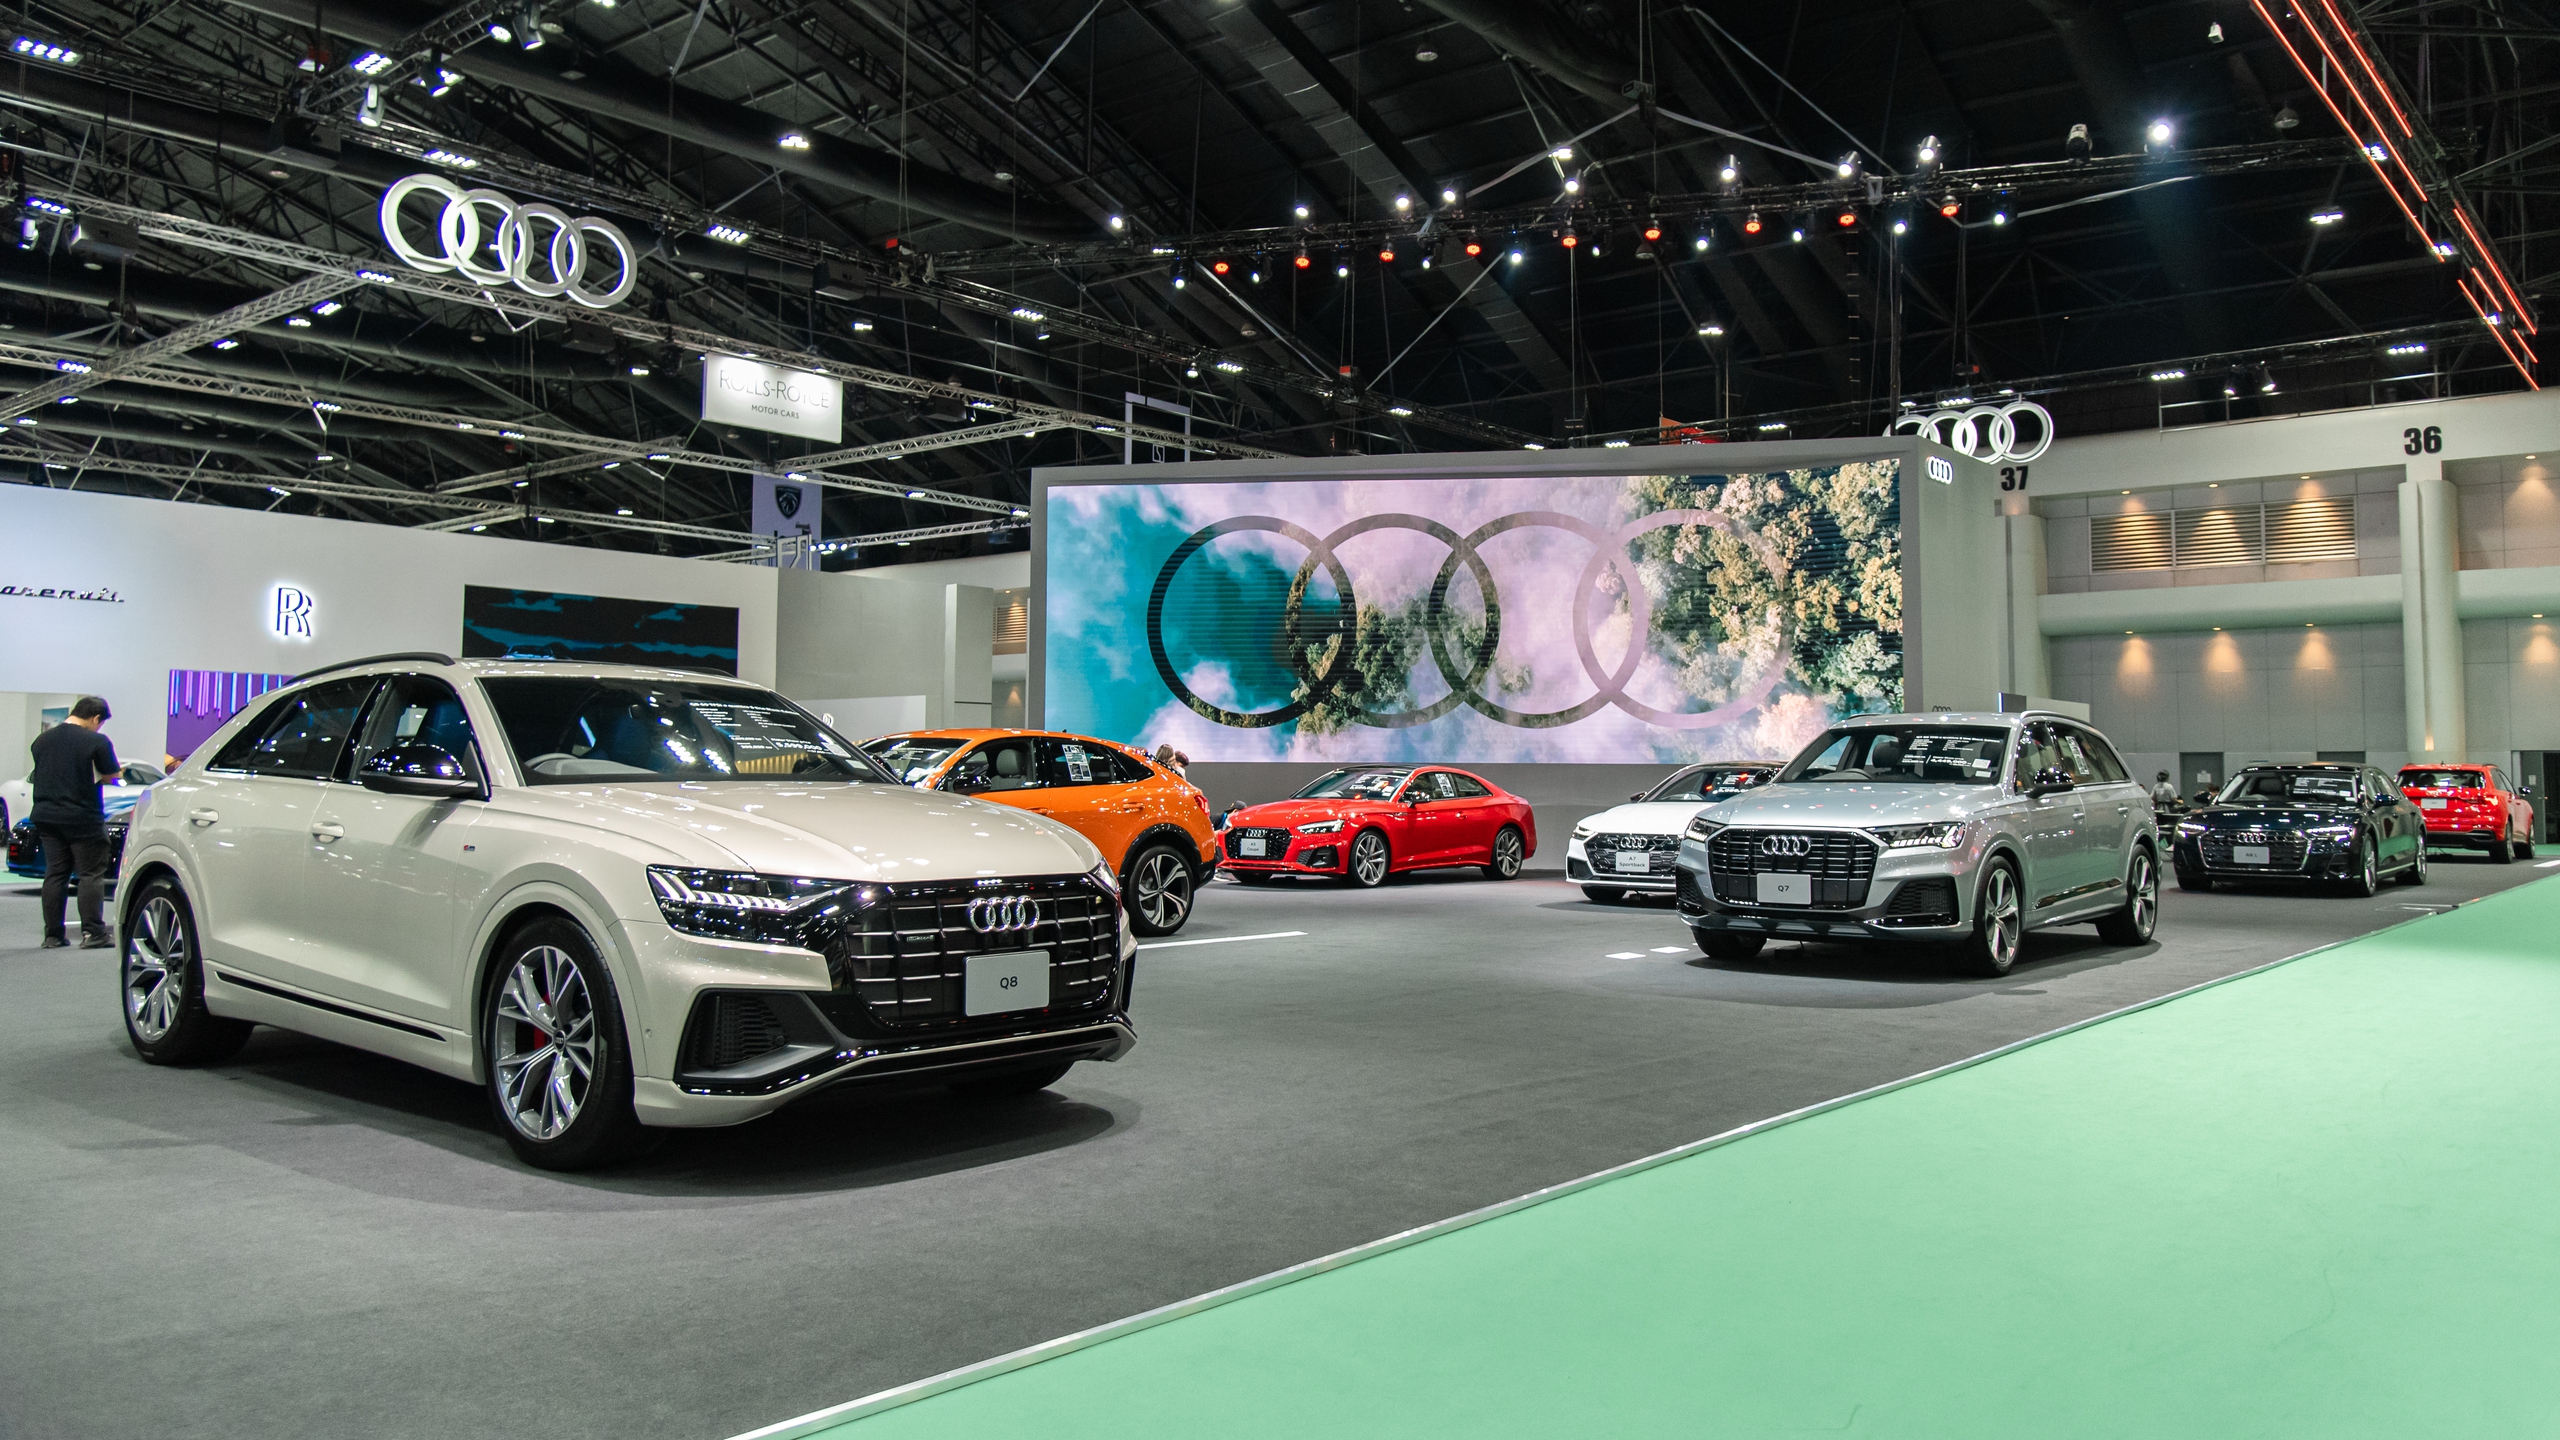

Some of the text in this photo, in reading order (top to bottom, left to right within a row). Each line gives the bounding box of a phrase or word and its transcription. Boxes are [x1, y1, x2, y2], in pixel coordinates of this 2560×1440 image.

[751, 404, 800, 419] MOTOR CARS
[2403, 425, 2442, 456] 36
[2000, 465, 2029, 491] 37
[0, 586, 125, 602] aserati
[1000, 976, 1018, 990] Q8
